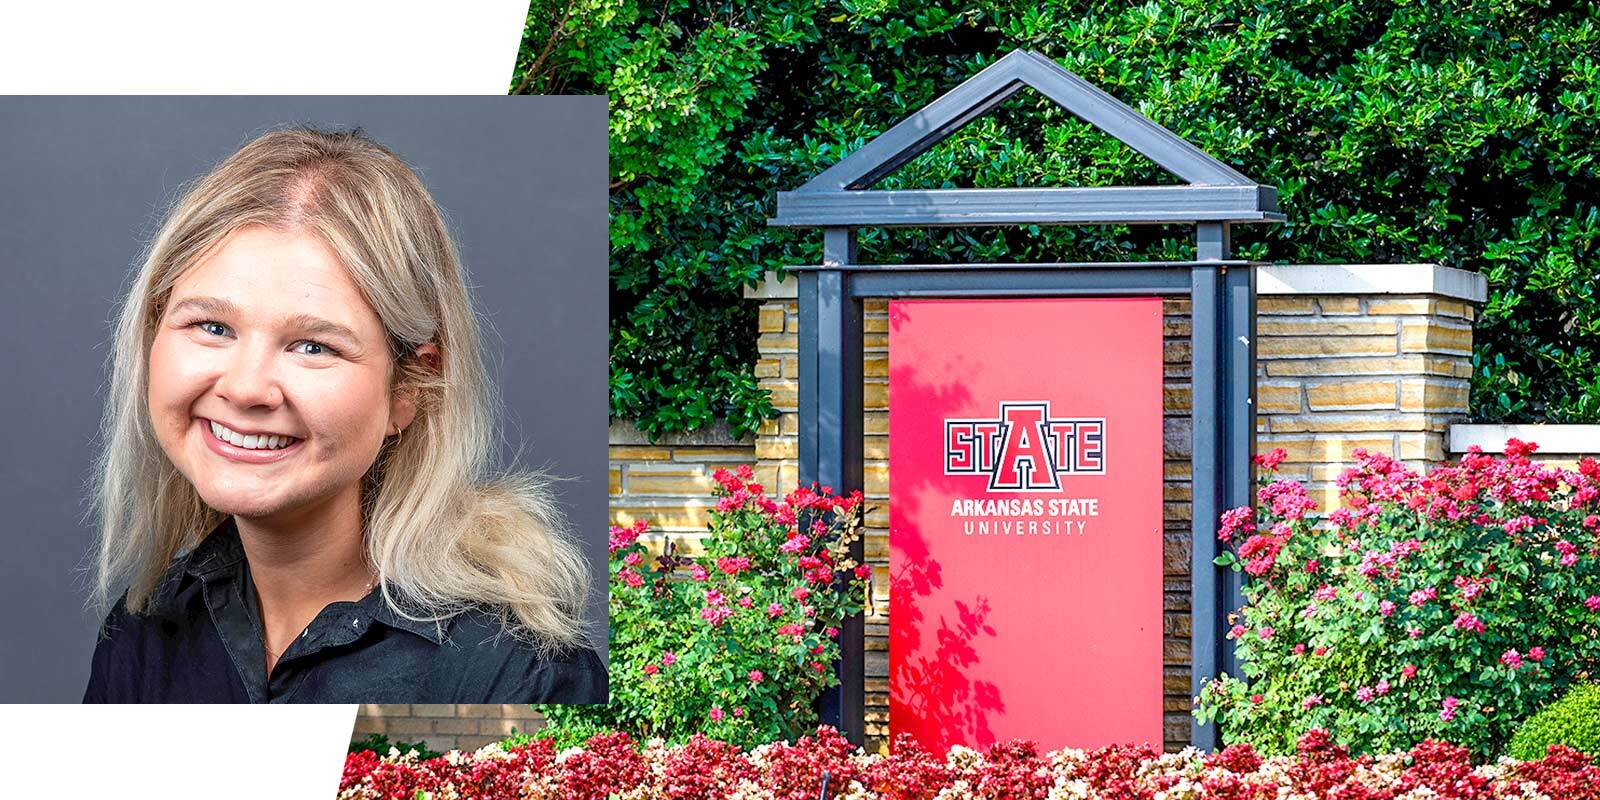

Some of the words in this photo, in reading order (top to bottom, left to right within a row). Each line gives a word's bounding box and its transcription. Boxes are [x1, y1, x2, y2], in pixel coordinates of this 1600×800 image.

[944, 401, 1106, 492] STATE
[951, 499, 1044, 516] ARKANSAS
[1048, 499, 1099, 516] STATE
[964, 520, 1087, 535] UNIVERSITY
